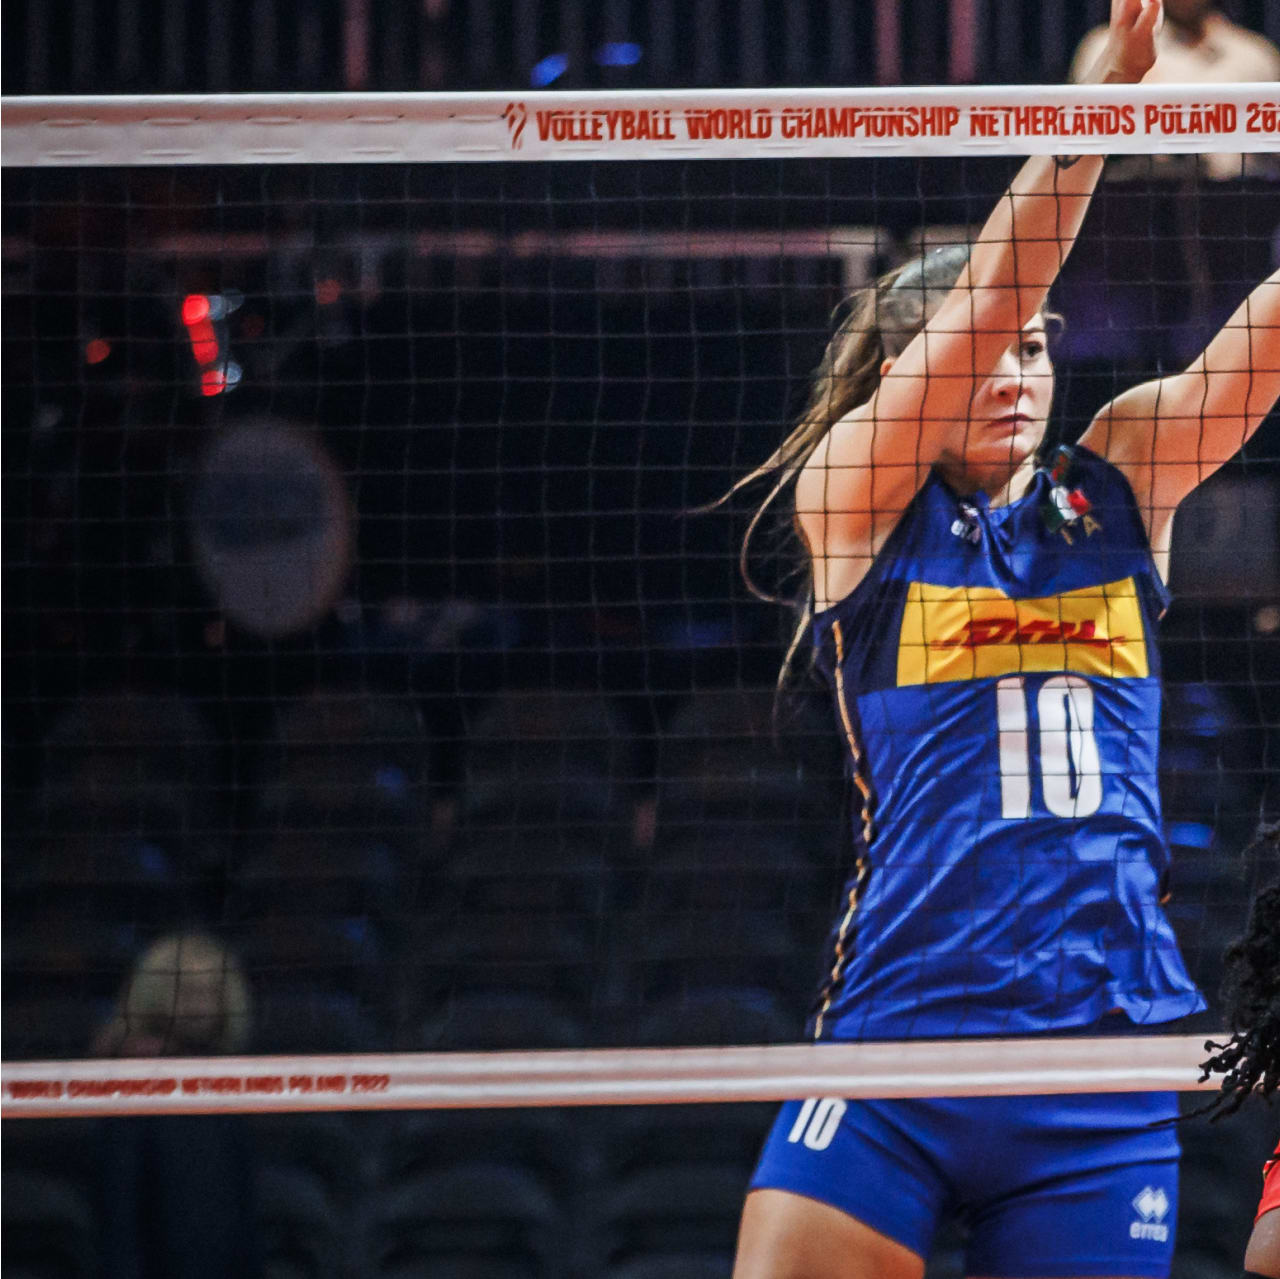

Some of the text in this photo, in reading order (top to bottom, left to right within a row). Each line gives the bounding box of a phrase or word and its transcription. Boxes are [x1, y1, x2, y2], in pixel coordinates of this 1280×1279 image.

[536, 109, 676, 142] VOLLEYBALL
[684, 109, 773, 140] WORLD
[780, 105, 960, 138] CHAMPIONSHIP
[969, 105, 1136, 137] NETHERLANDS
[1144, 104, 1238, 135] POLAND
[961, 618, 1110, 649] DHL
[997, 676, 1102, 820] 10
[787, 1096, 847, 1152] 10
